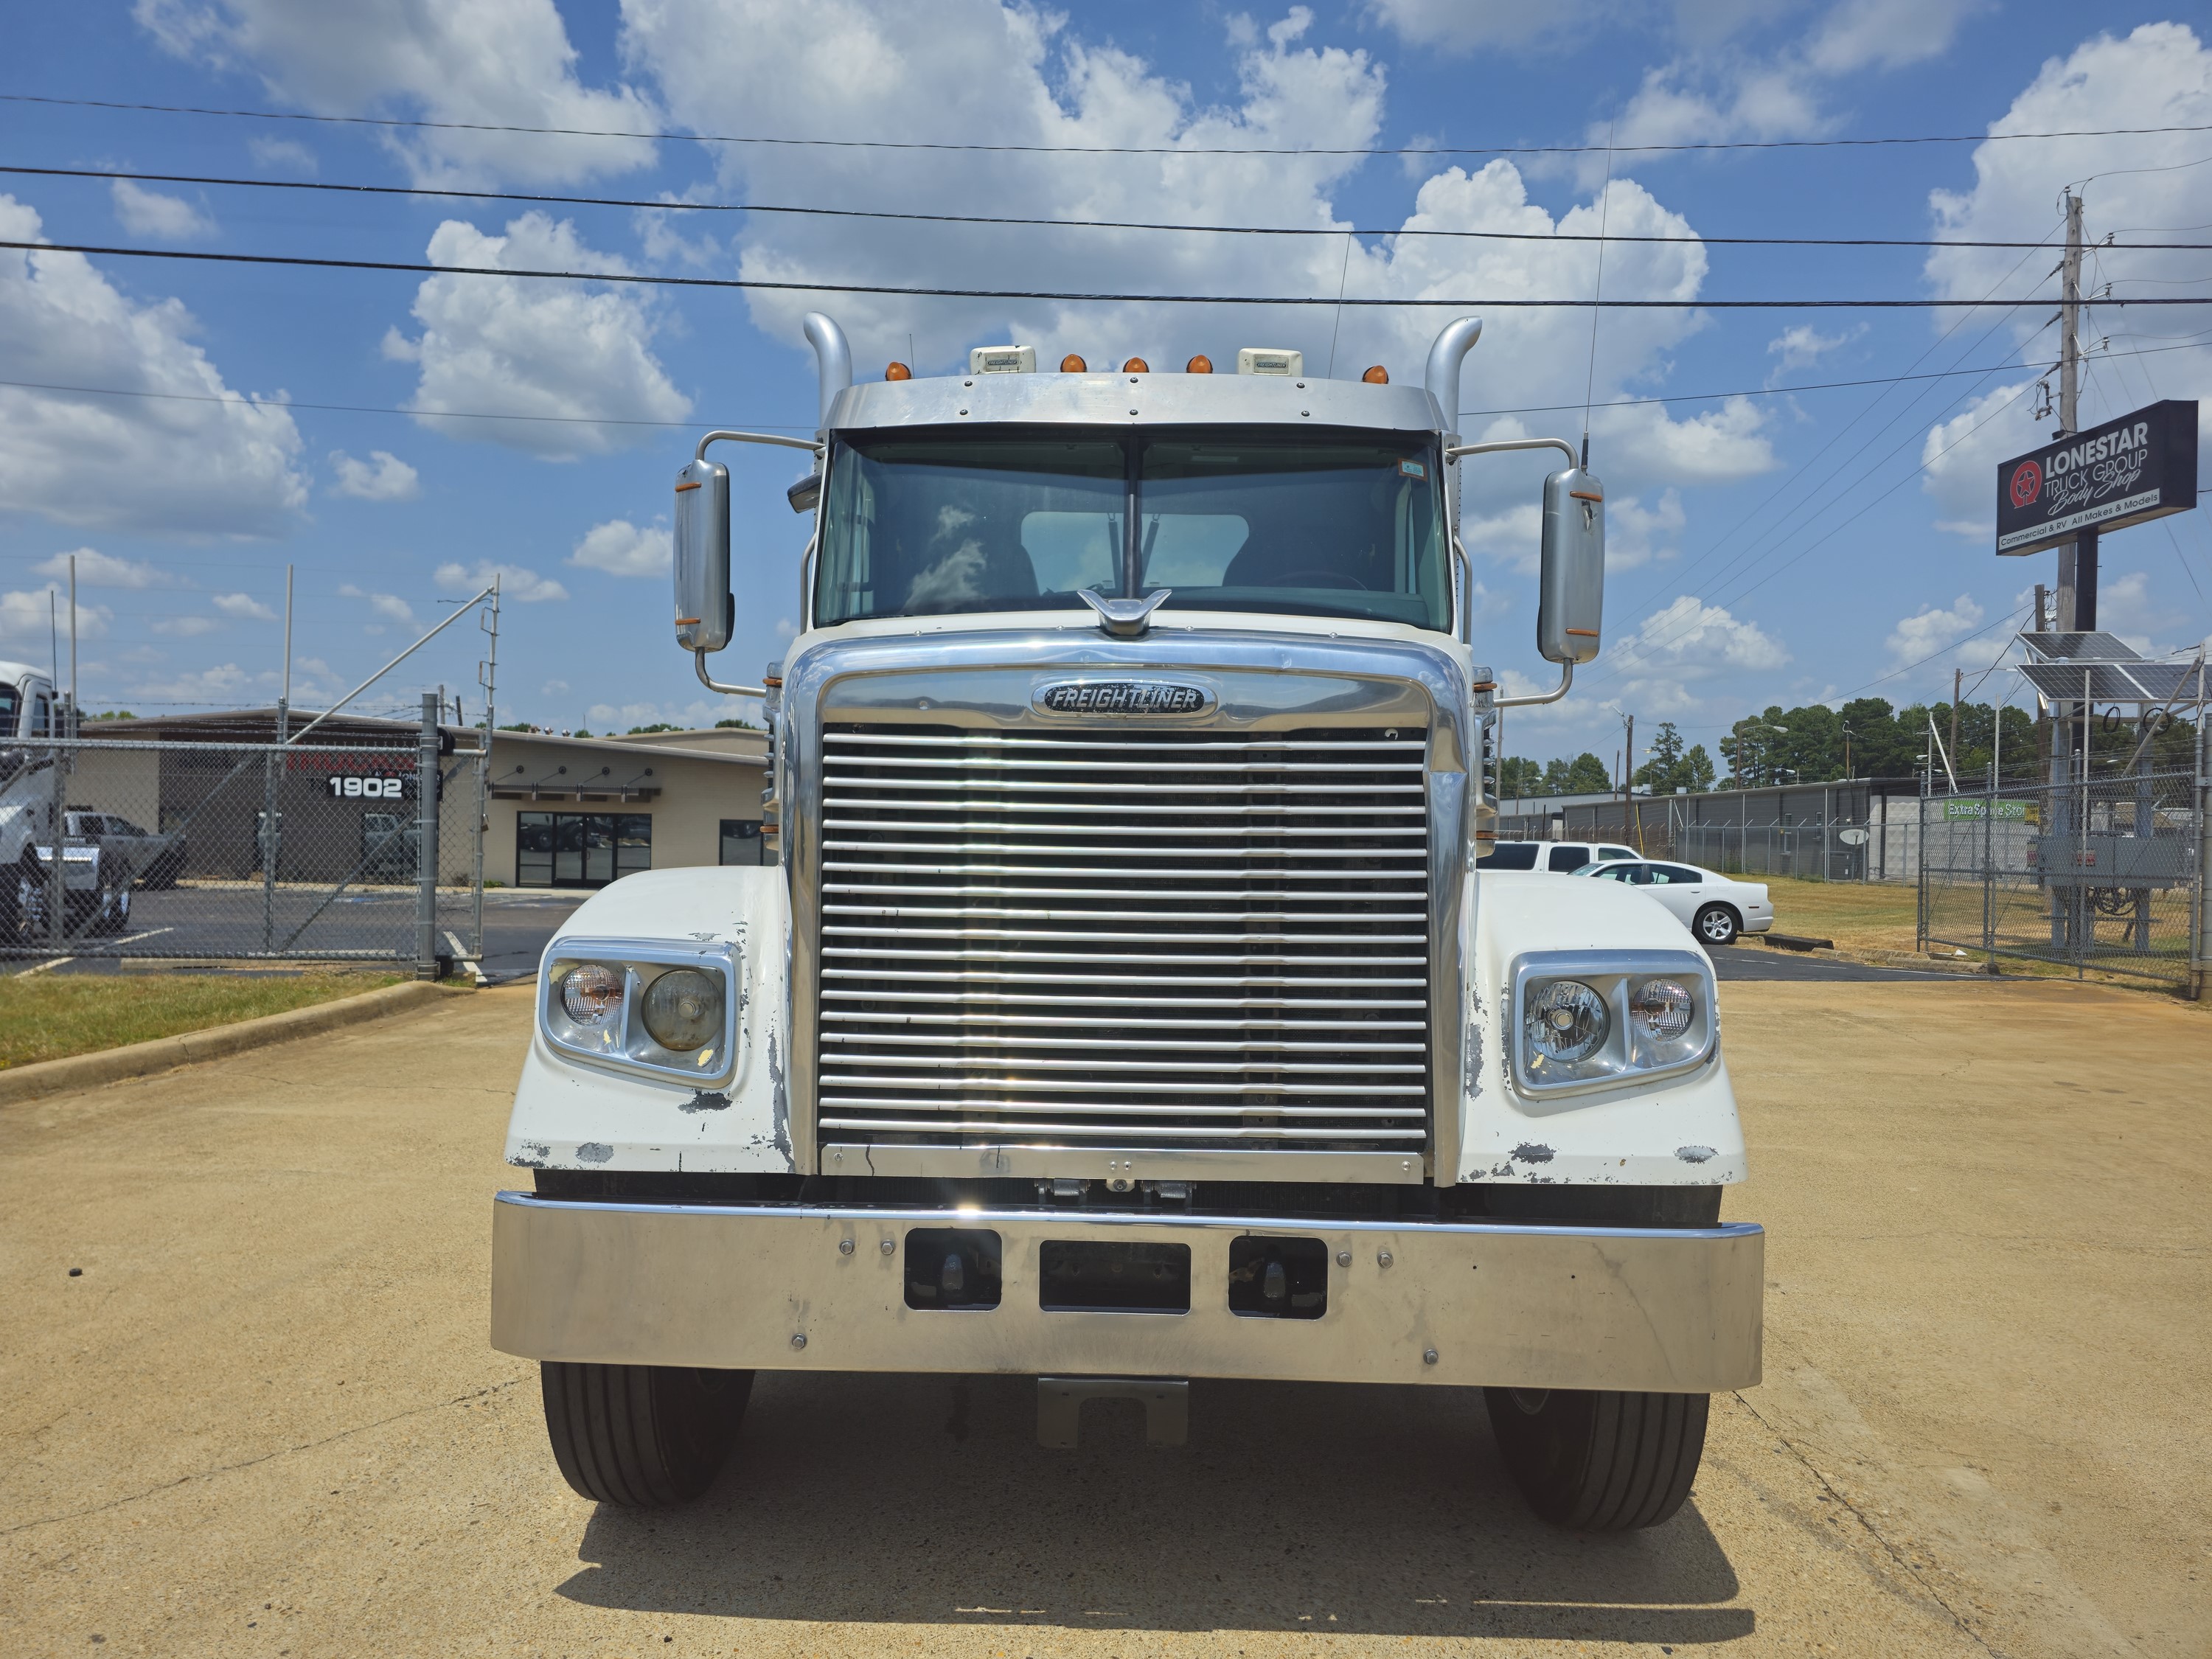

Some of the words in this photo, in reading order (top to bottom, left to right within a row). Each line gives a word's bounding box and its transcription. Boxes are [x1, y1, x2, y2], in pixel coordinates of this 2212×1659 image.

[2044, 468, 2088, 498] TRUCK
[2093, 449, 2148, 481] GROUP
[2045, 422, 2148, 479] LONESTAR
[2048, 481, 2093, 516] Body
[2093, 469, 2142, 498] Shop
[2000, 526, 2047, 546] Commercial
[2048, 524, 2054, 532] &
[2056, 520, 2067, 530] RV
[2071, 516, 2082, 526] All
[2084, 507, 2112, 521] Makes
[2115, 504, 2122, 512] &
[2124, 494, 2158, 510] Models
[1051, 688, 1197, 709] FREIGHTLINER
[330, 777, 403, 798] 1902
[1950, 803, 1973, 816] Extra
[1974, 803, 2004, 818] Spe
